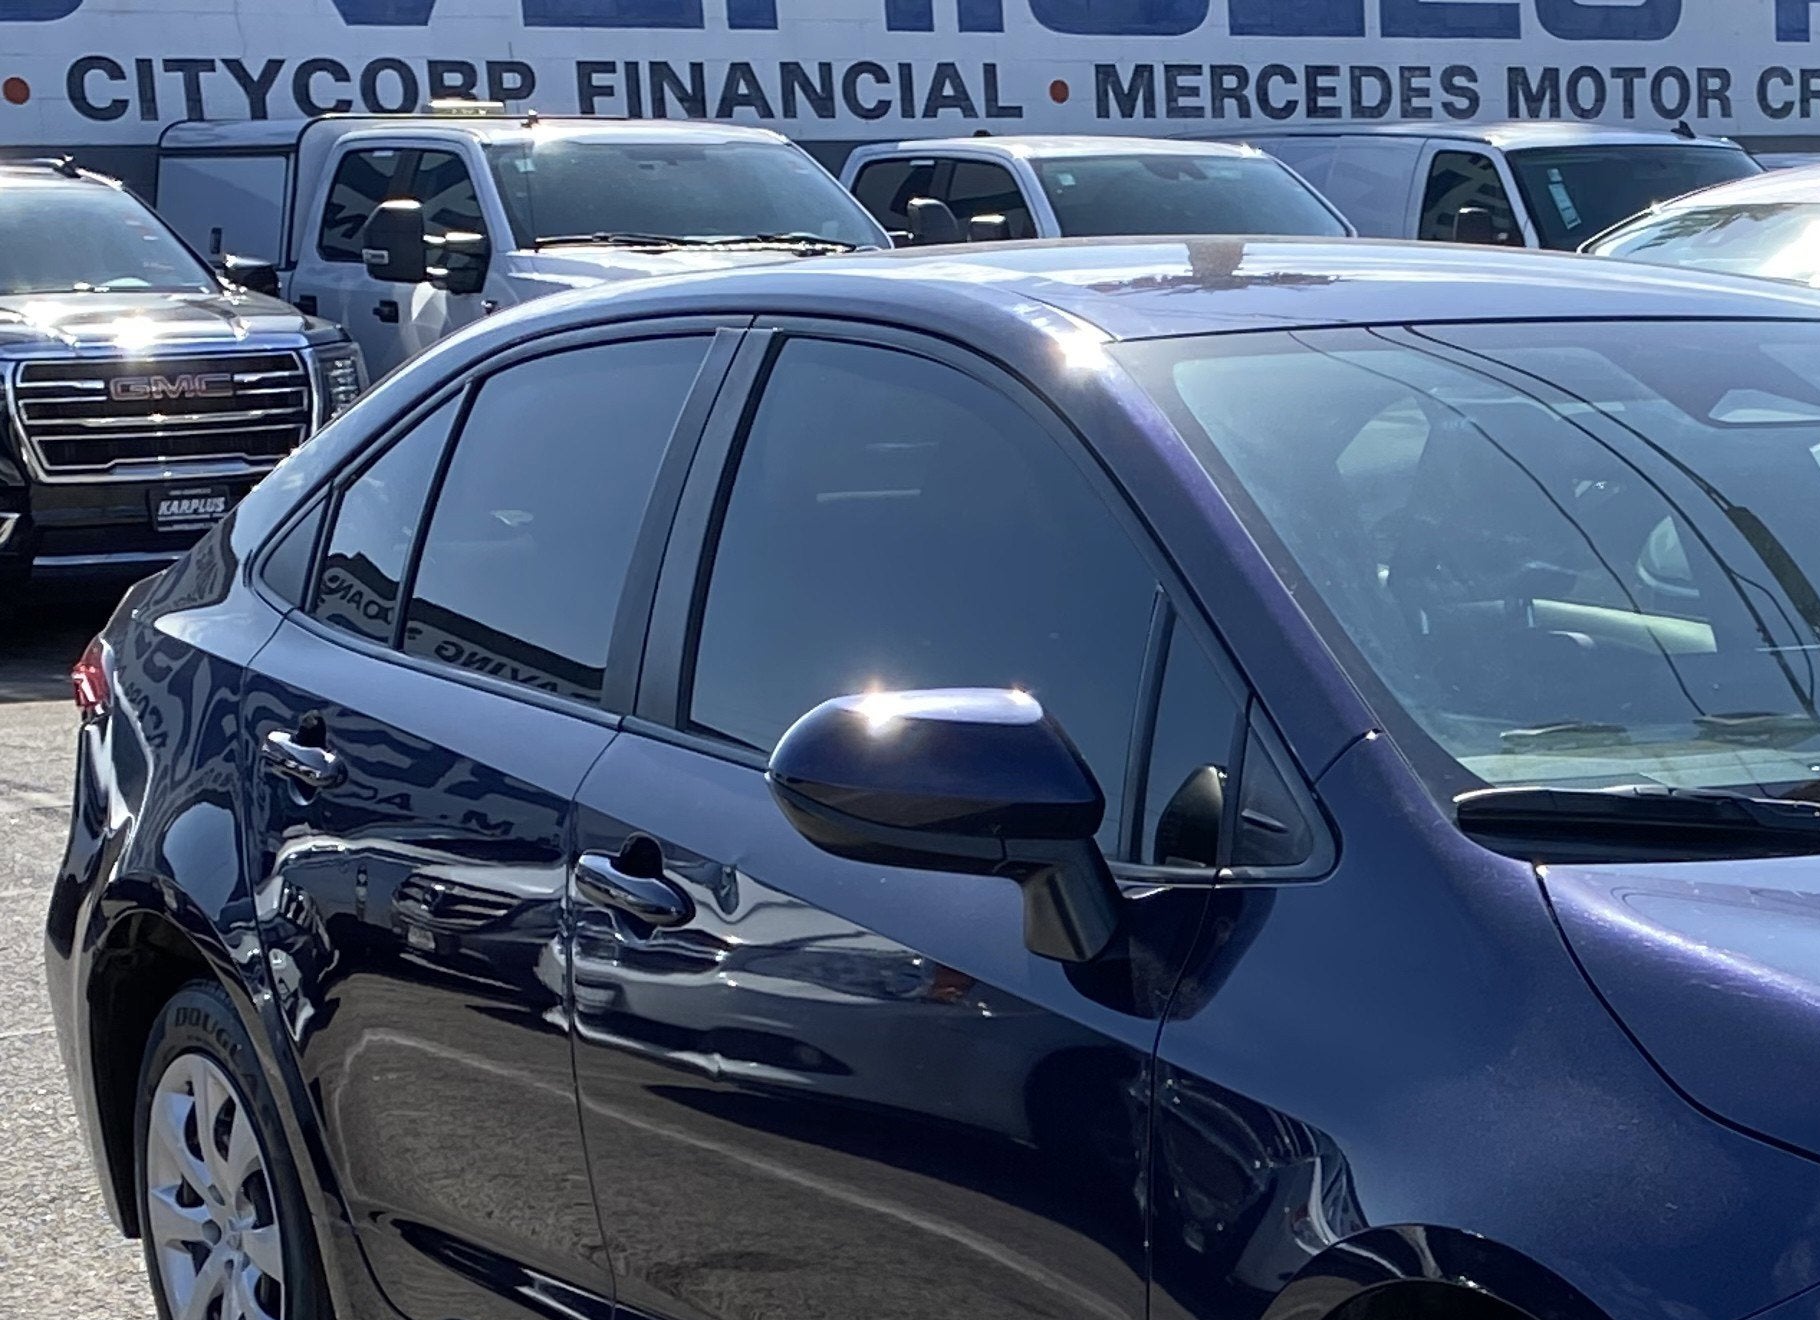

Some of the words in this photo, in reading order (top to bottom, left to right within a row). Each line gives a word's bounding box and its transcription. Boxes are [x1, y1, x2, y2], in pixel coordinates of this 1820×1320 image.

[66, 55, 536, 121] CITYCORP
[575, 60, 1023, 120] FINANCIAL
[1094, 62, 1480, 120] MERCEDES
[1507, 64, 1733, 121] MOTOR
[110, 373, 233, 401] GMC
[157, 497, 226, 516] KARPLUS
